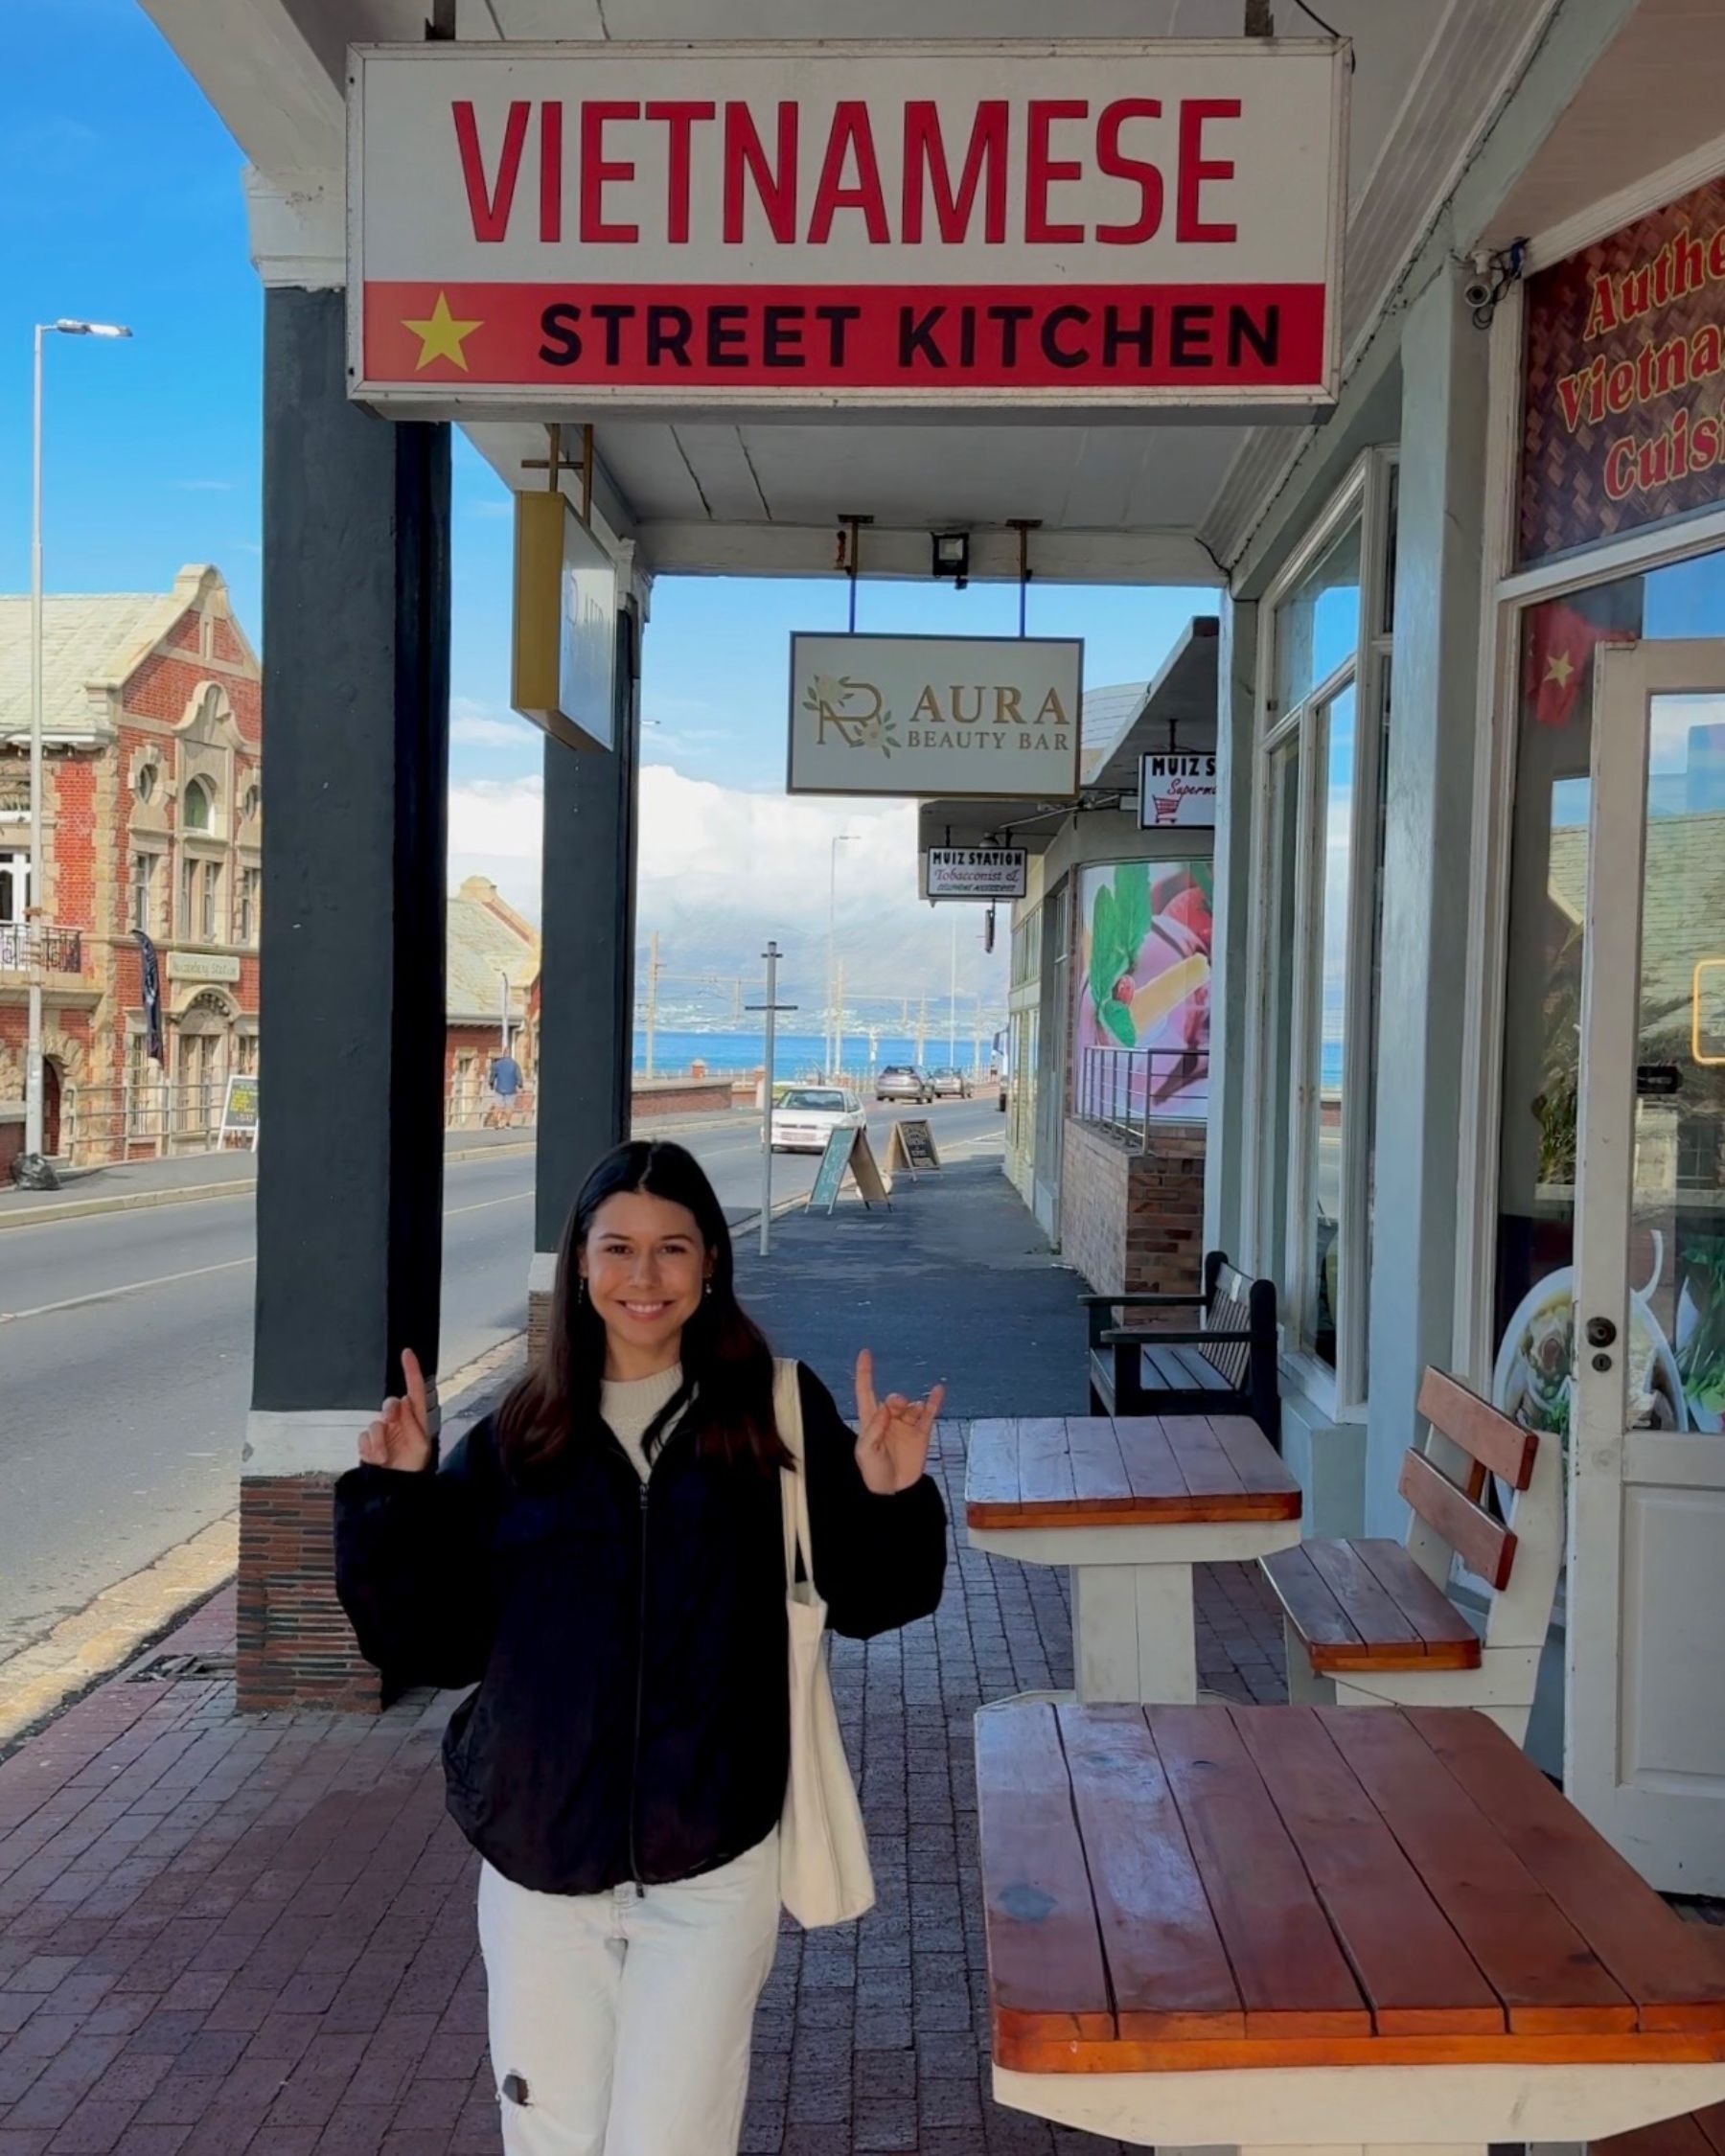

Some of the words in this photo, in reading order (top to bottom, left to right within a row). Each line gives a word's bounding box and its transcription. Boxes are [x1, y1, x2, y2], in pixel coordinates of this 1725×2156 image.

[450, 98, 1242, 245] VIETNAMESE
[538, 303, 861, 368] STREET
[898, 303, 1280, 368] KITCHEN
[1557, 322, 1725, 433] Vietna
[1603, 401, 1725, 500] Cuis
[909, 684, 1070, 726] AURA
[908, 730, 1006, 749] BEAUTY
[1019, 733, 1070, 751] BAR
[1152, 757, 1200, 776] MUIZ
[932, 852, 965, 865] MUIZ
[969, 852, 1023, 866] STATION
